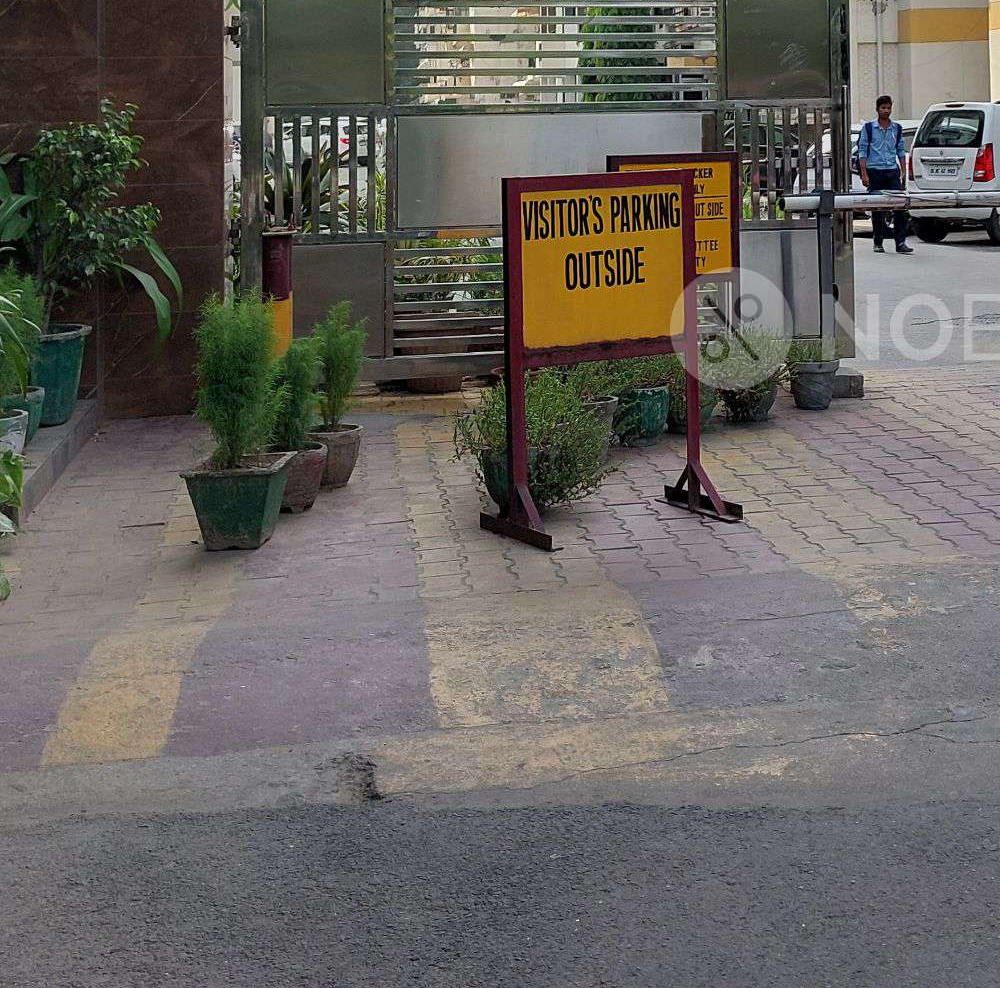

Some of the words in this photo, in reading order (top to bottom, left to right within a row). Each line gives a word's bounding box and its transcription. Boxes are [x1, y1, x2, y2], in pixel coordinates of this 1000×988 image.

[522, 195, 604, 241] VISITOR'S
[610, 192, 681, 234] PARKING
[707, 202, 725, 216] SIDE
[565, 246, 646, 291] OUTSIDE
